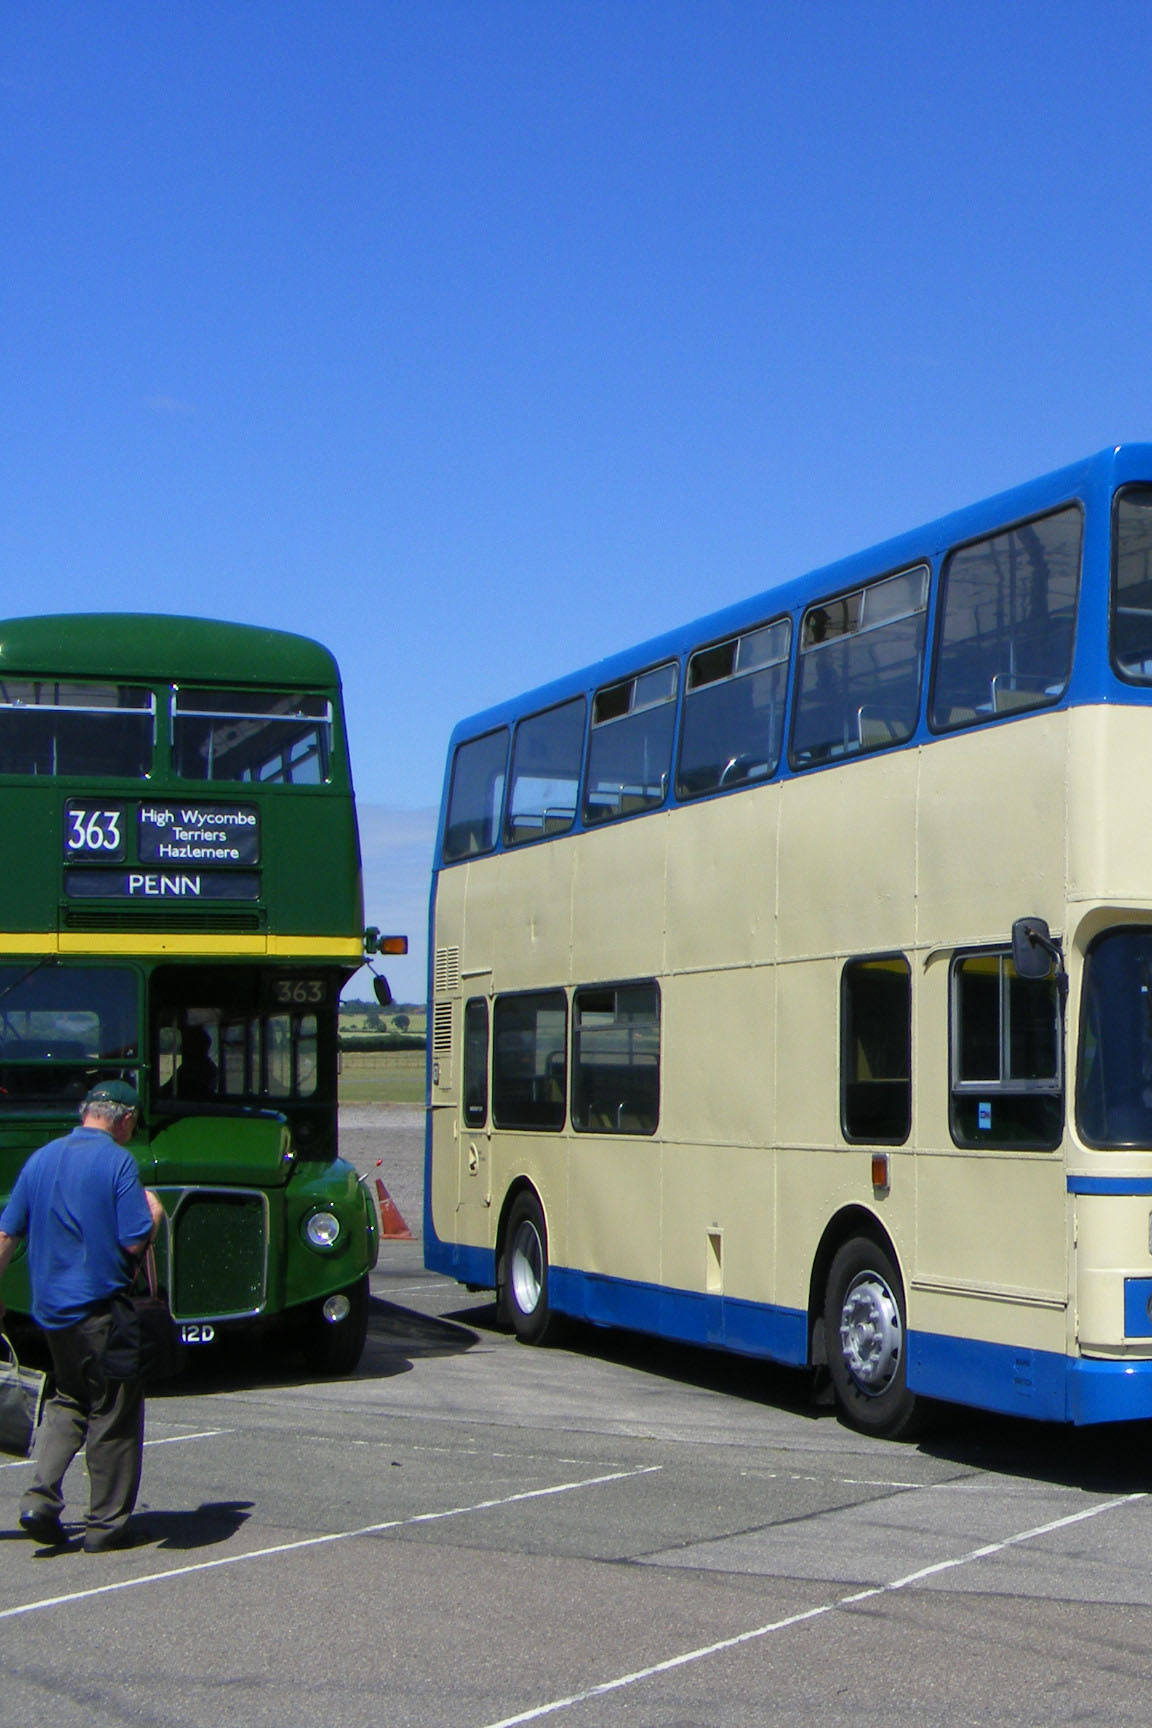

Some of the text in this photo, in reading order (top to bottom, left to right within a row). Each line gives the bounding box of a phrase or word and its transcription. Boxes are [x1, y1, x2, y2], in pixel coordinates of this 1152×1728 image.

[141, 808, 257, 827] High Wycombe
[67, 810, 121, 850] 363
[172, 826, 227, 843] Terriers
[159, 843, 239, 860] Hazlemere
[128, 874, 201, 896] PENN
[278, 981, 323, 1002] 363
